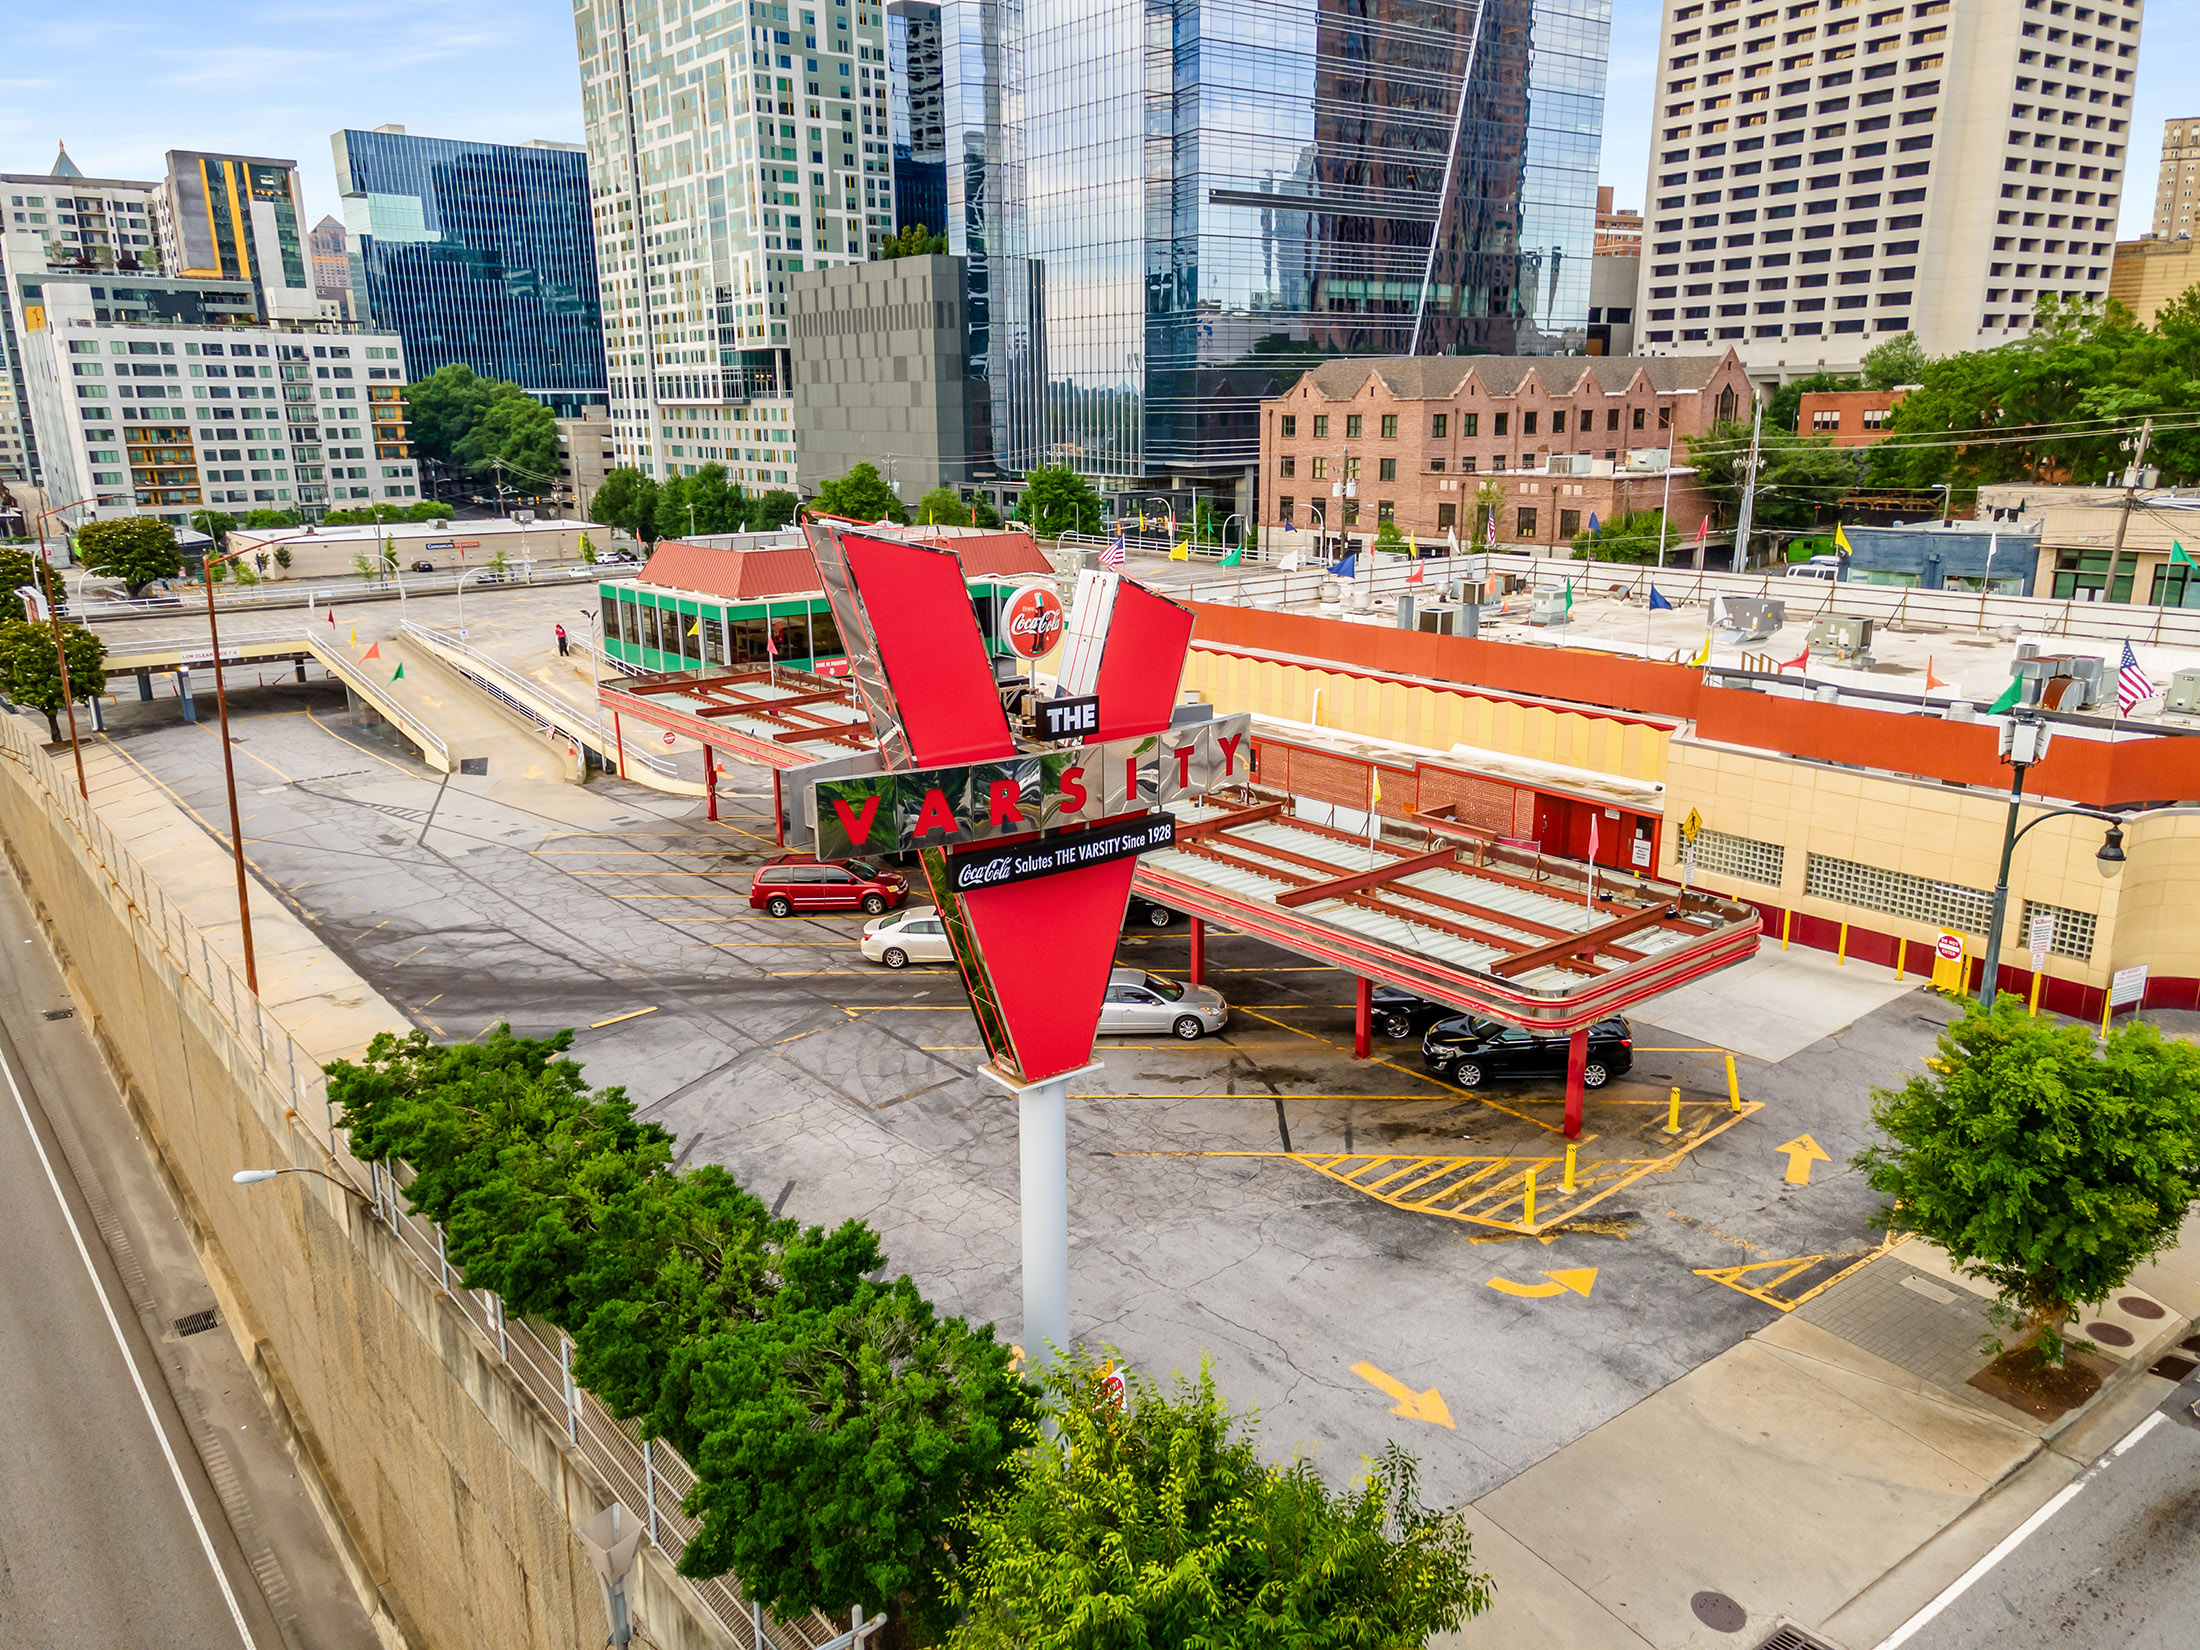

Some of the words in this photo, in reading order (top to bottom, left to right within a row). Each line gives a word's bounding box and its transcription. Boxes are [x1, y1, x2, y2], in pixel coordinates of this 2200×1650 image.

[1047, 703, 1095, 733] THE
[834, 733, 1243, 846] VARSITY
[958, 856, 1013, 888] Coca-Cola
[1015, 855, 1053, 874] Salutes
[1055, 847, 1076, 866] THE
[1078, 836, 1121, 861] VARSITY
[1122, 833, 1146, 851] Since
[1147, 823, 1172, 845] 1928
